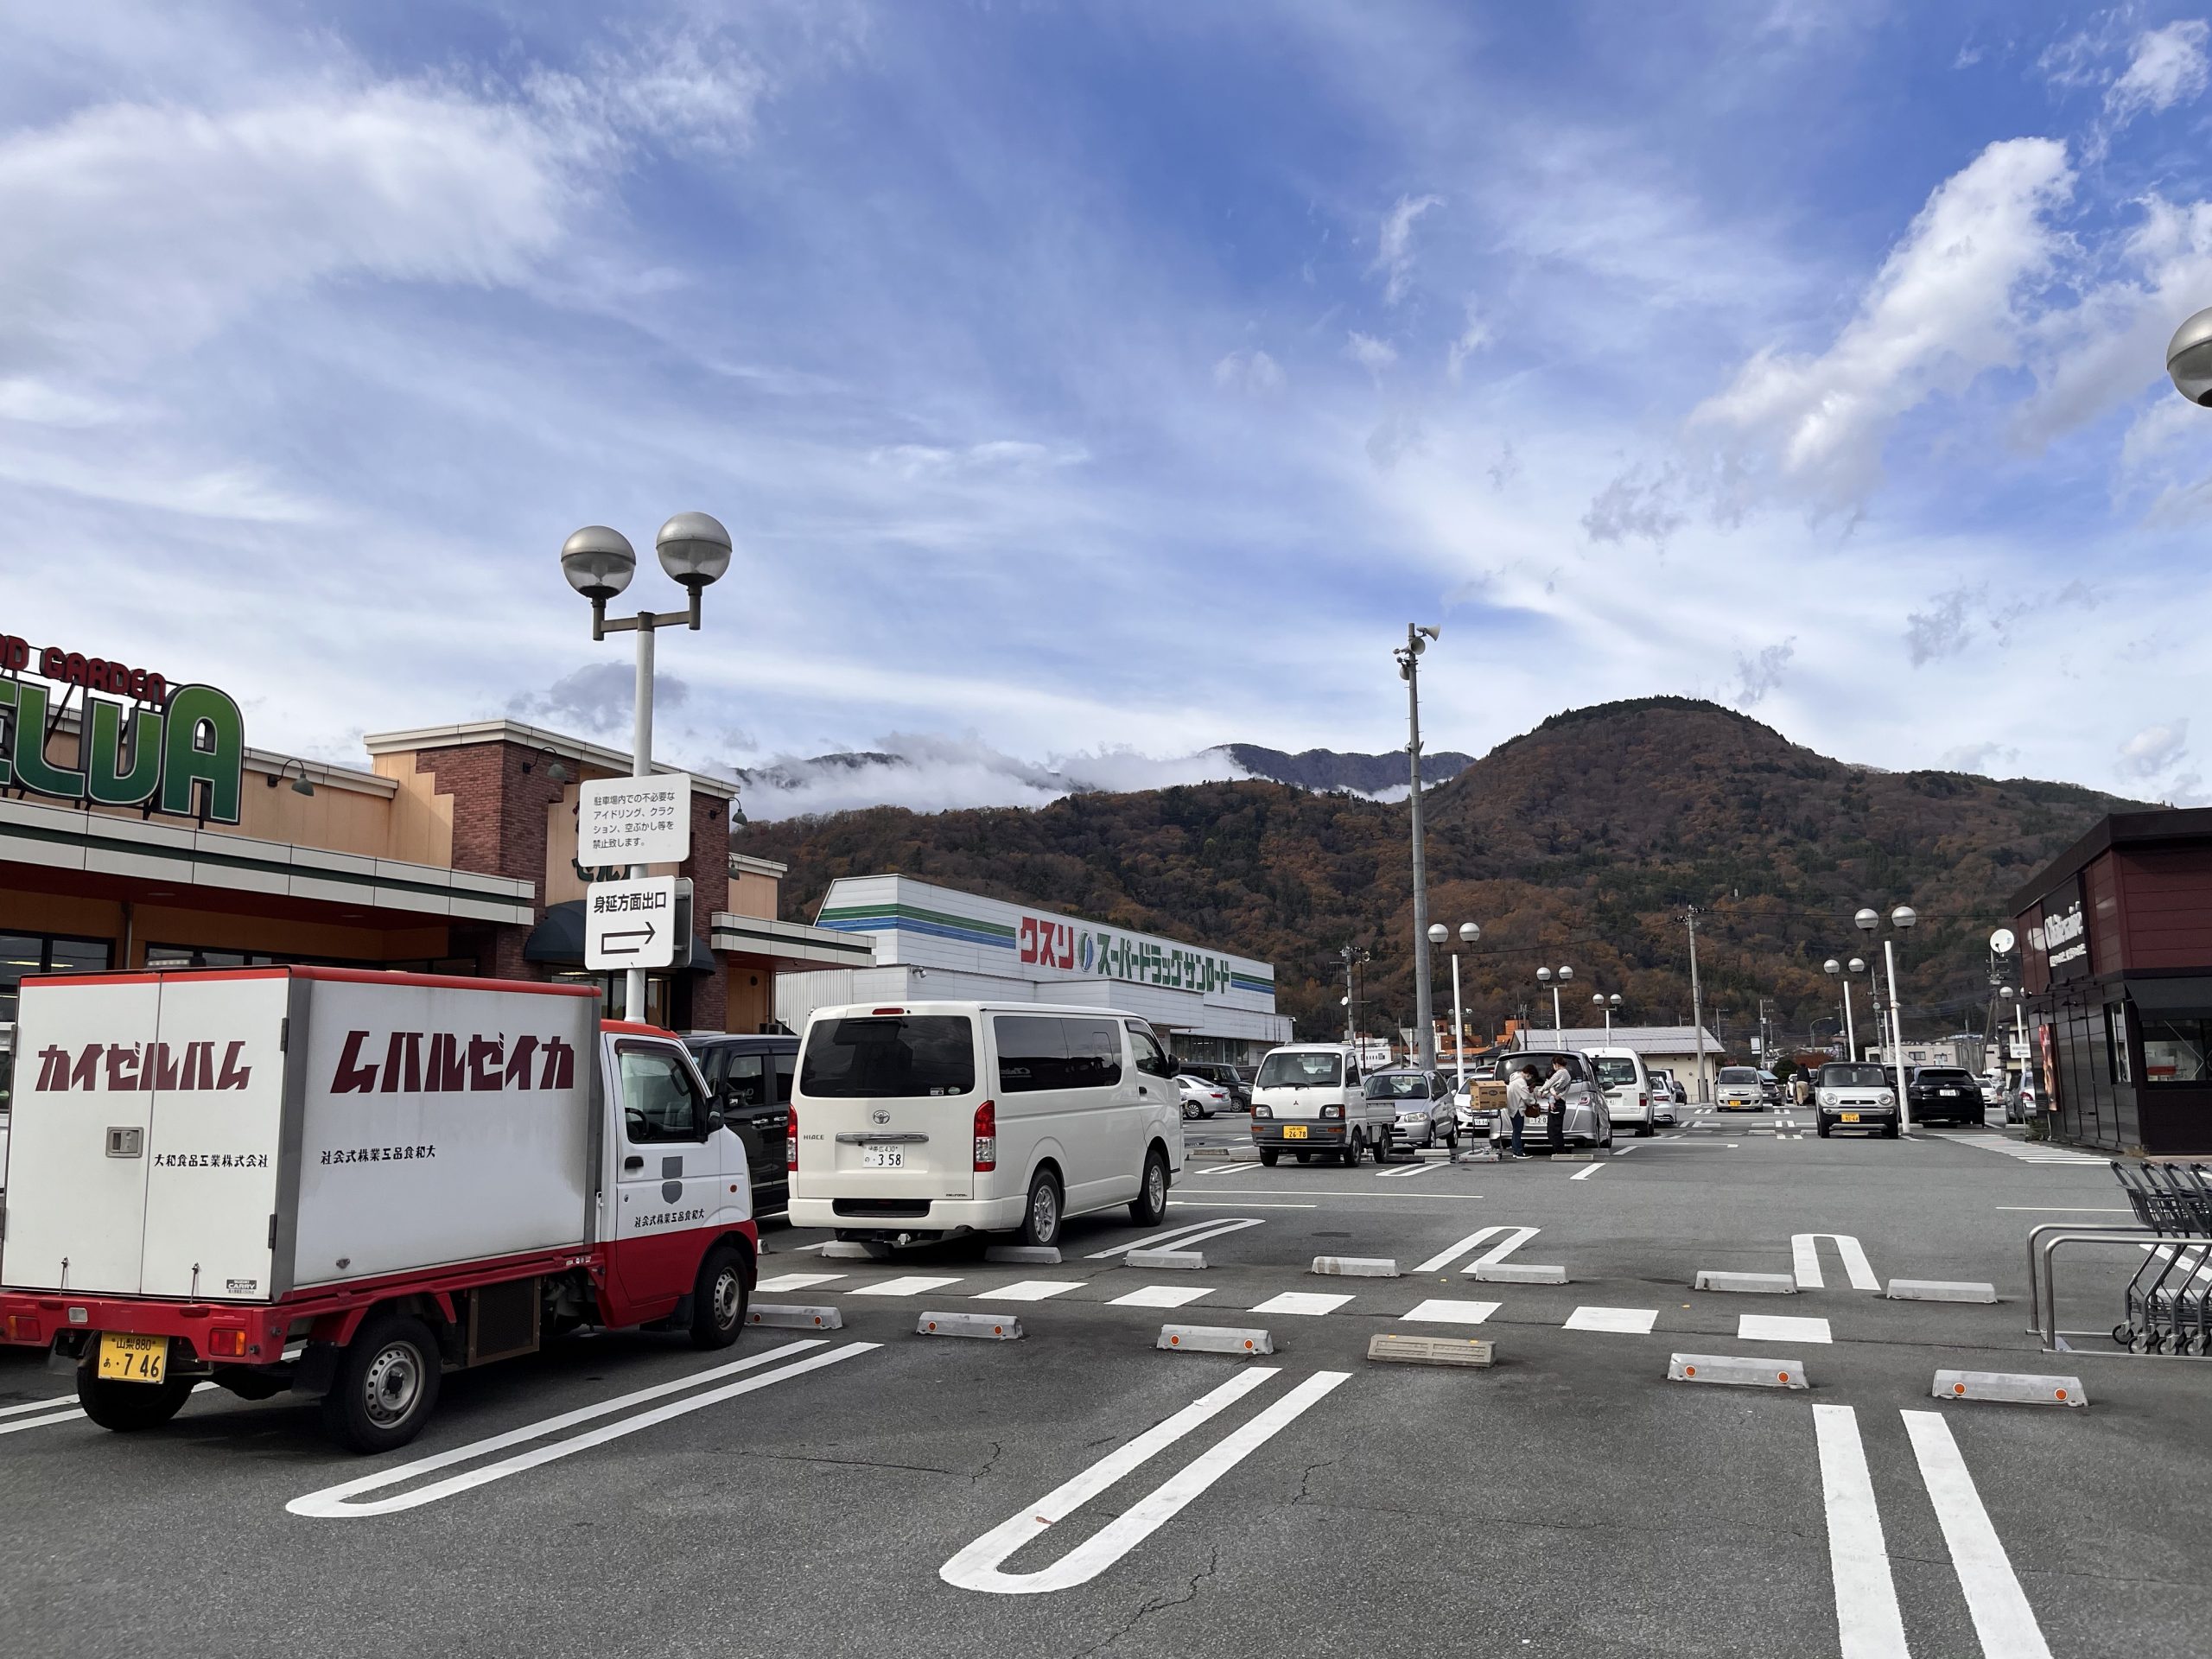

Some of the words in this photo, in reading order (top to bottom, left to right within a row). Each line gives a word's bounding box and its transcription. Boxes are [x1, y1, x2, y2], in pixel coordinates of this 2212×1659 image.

[40, 646, 167, 704] GARDEN
[594, 791, 675, 806] 駐車場内での不必要な
[594, 806, 675, 820] アイドリング、クラク
[593, 821, 674, 834] ション、空ぶかし等を
[593, 837, 645, 849] 禁止致します。
[594, 892, 666, 913] 身延方面出口
[1020, 916, 1073, 969] クスリ
[1097, 933, 1229, 994] スーパードラッグサンロード
[154, 1154, 268, 1167] 大和食品工業株式会社
[116, 1337, 151, 1351] 山梨880
[103, 1357, 111, 1369] あ
